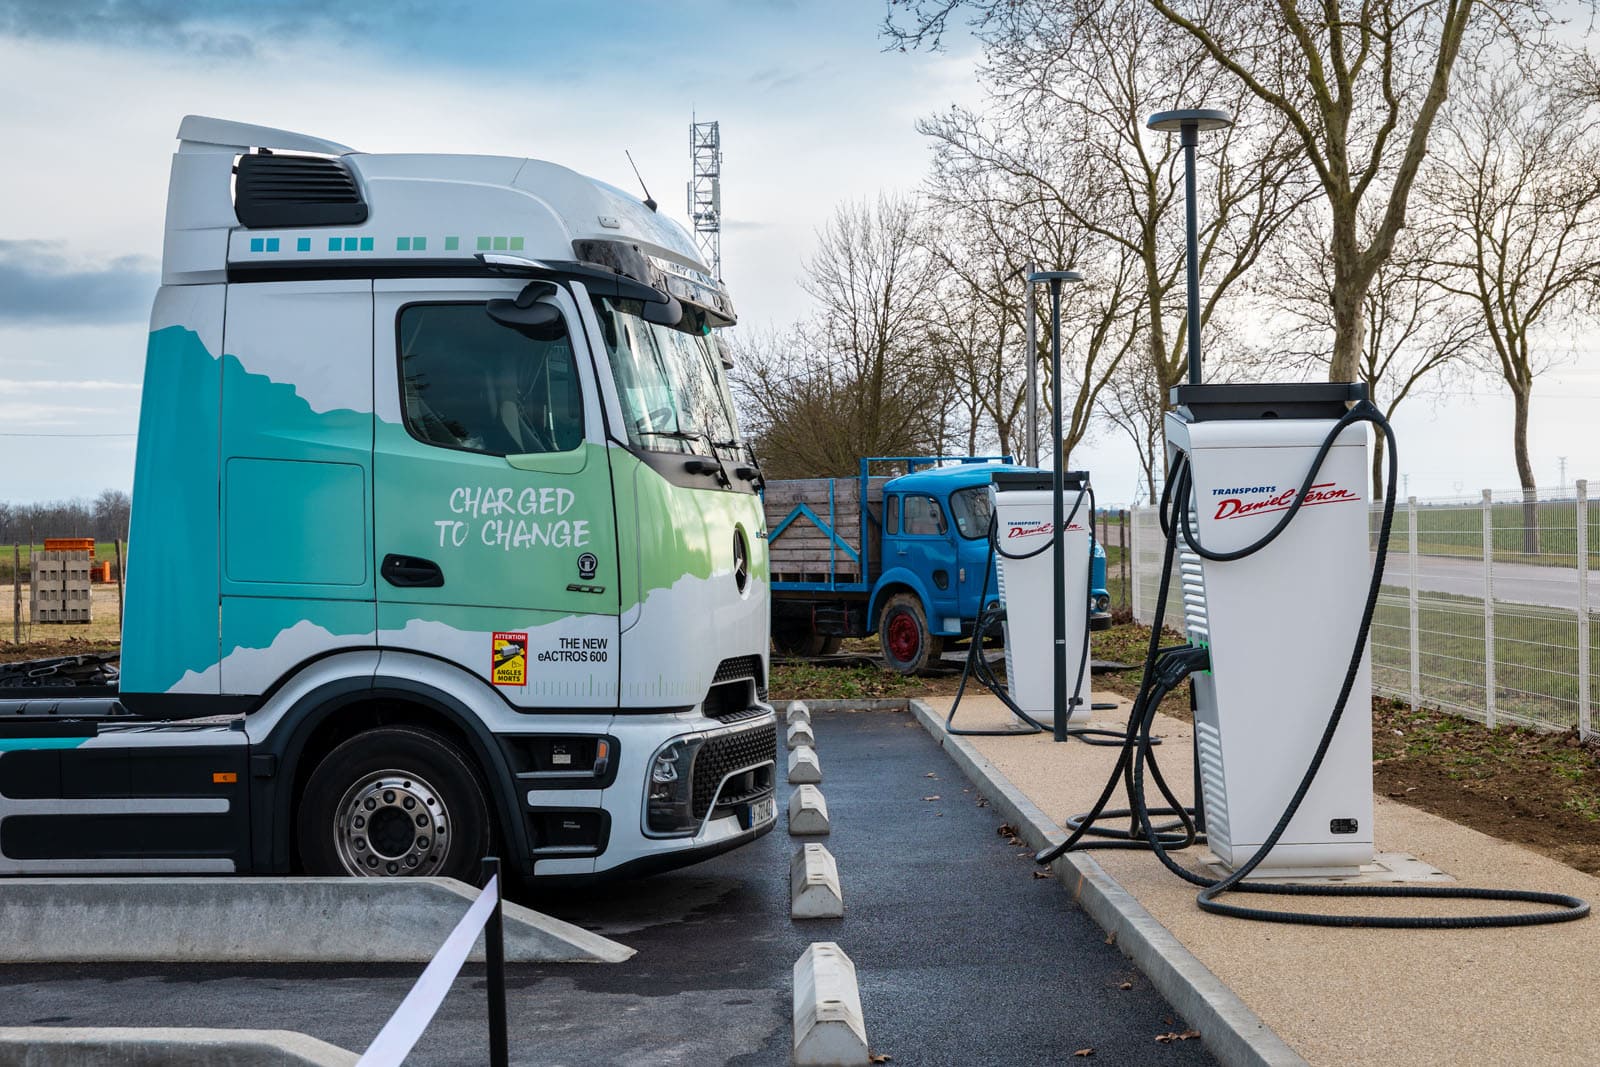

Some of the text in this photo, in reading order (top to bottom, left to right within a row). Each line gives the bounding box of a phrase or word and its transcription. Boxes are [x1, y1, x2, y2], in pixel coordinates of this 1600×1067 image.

[1212, 486, 1276, 495] TRANSPORTS
[450, 486, 575, 518] CHARGED
[1214, 488, 1295, 519] Daniel
[434, 519, 590, 551] TO CHANGE
[559, 637, 608, 650] THE NEW
[537, 650, 608, 662] eACTROS 600
